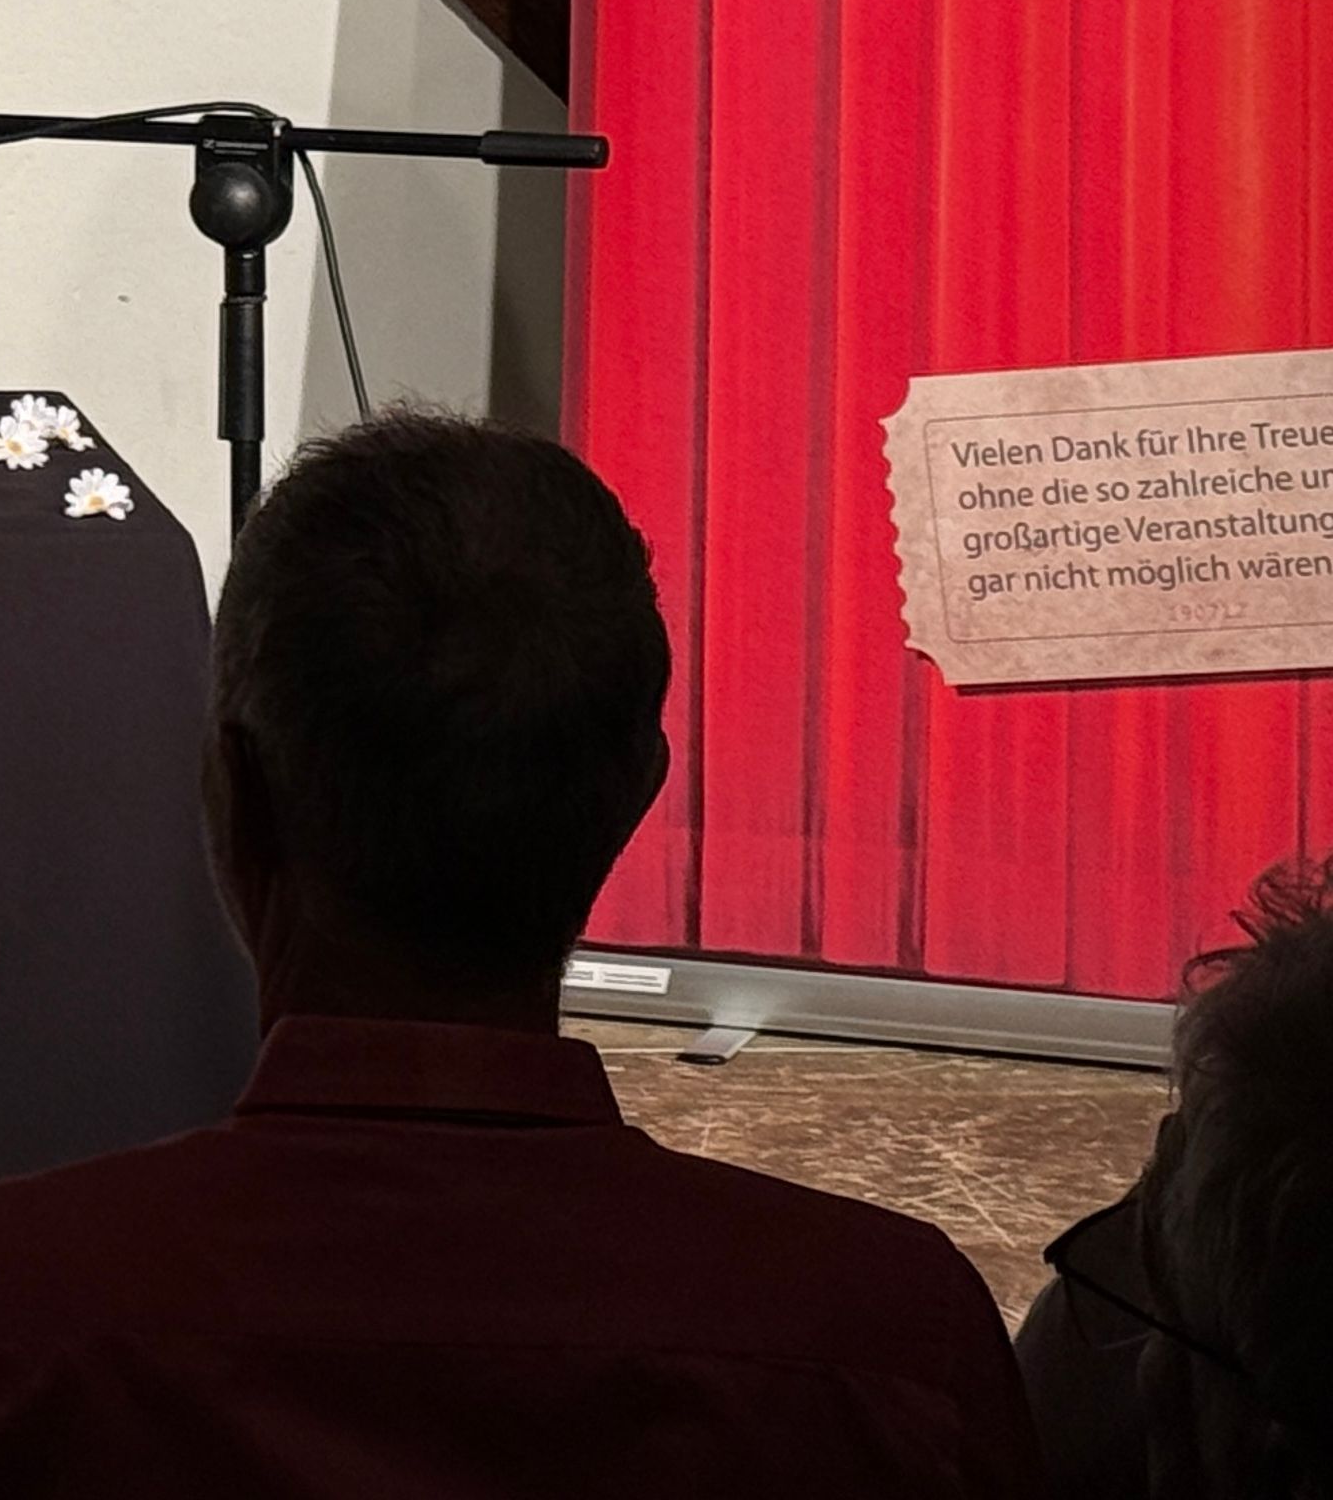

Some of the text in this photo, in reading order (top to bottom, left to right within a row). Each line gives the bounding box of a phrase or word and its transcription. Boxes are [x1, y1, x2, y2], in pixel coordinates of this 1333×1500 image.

[951, 422, 1333, 468] Vielen Dank für Ihre Treue
[958, 482, 1034, 510] ohne
[1042, 478, 1088, 505] die
[1096, 478, 1130, 502] so
[1137, 465, 1294, 500] zahlreiche
[963, 522, 1121, 558] großartige
[967, 570, 1016, 600] gar
[1024, 561, 1101, 591] nicht
[1107, 555, 1231, 591] möglich
